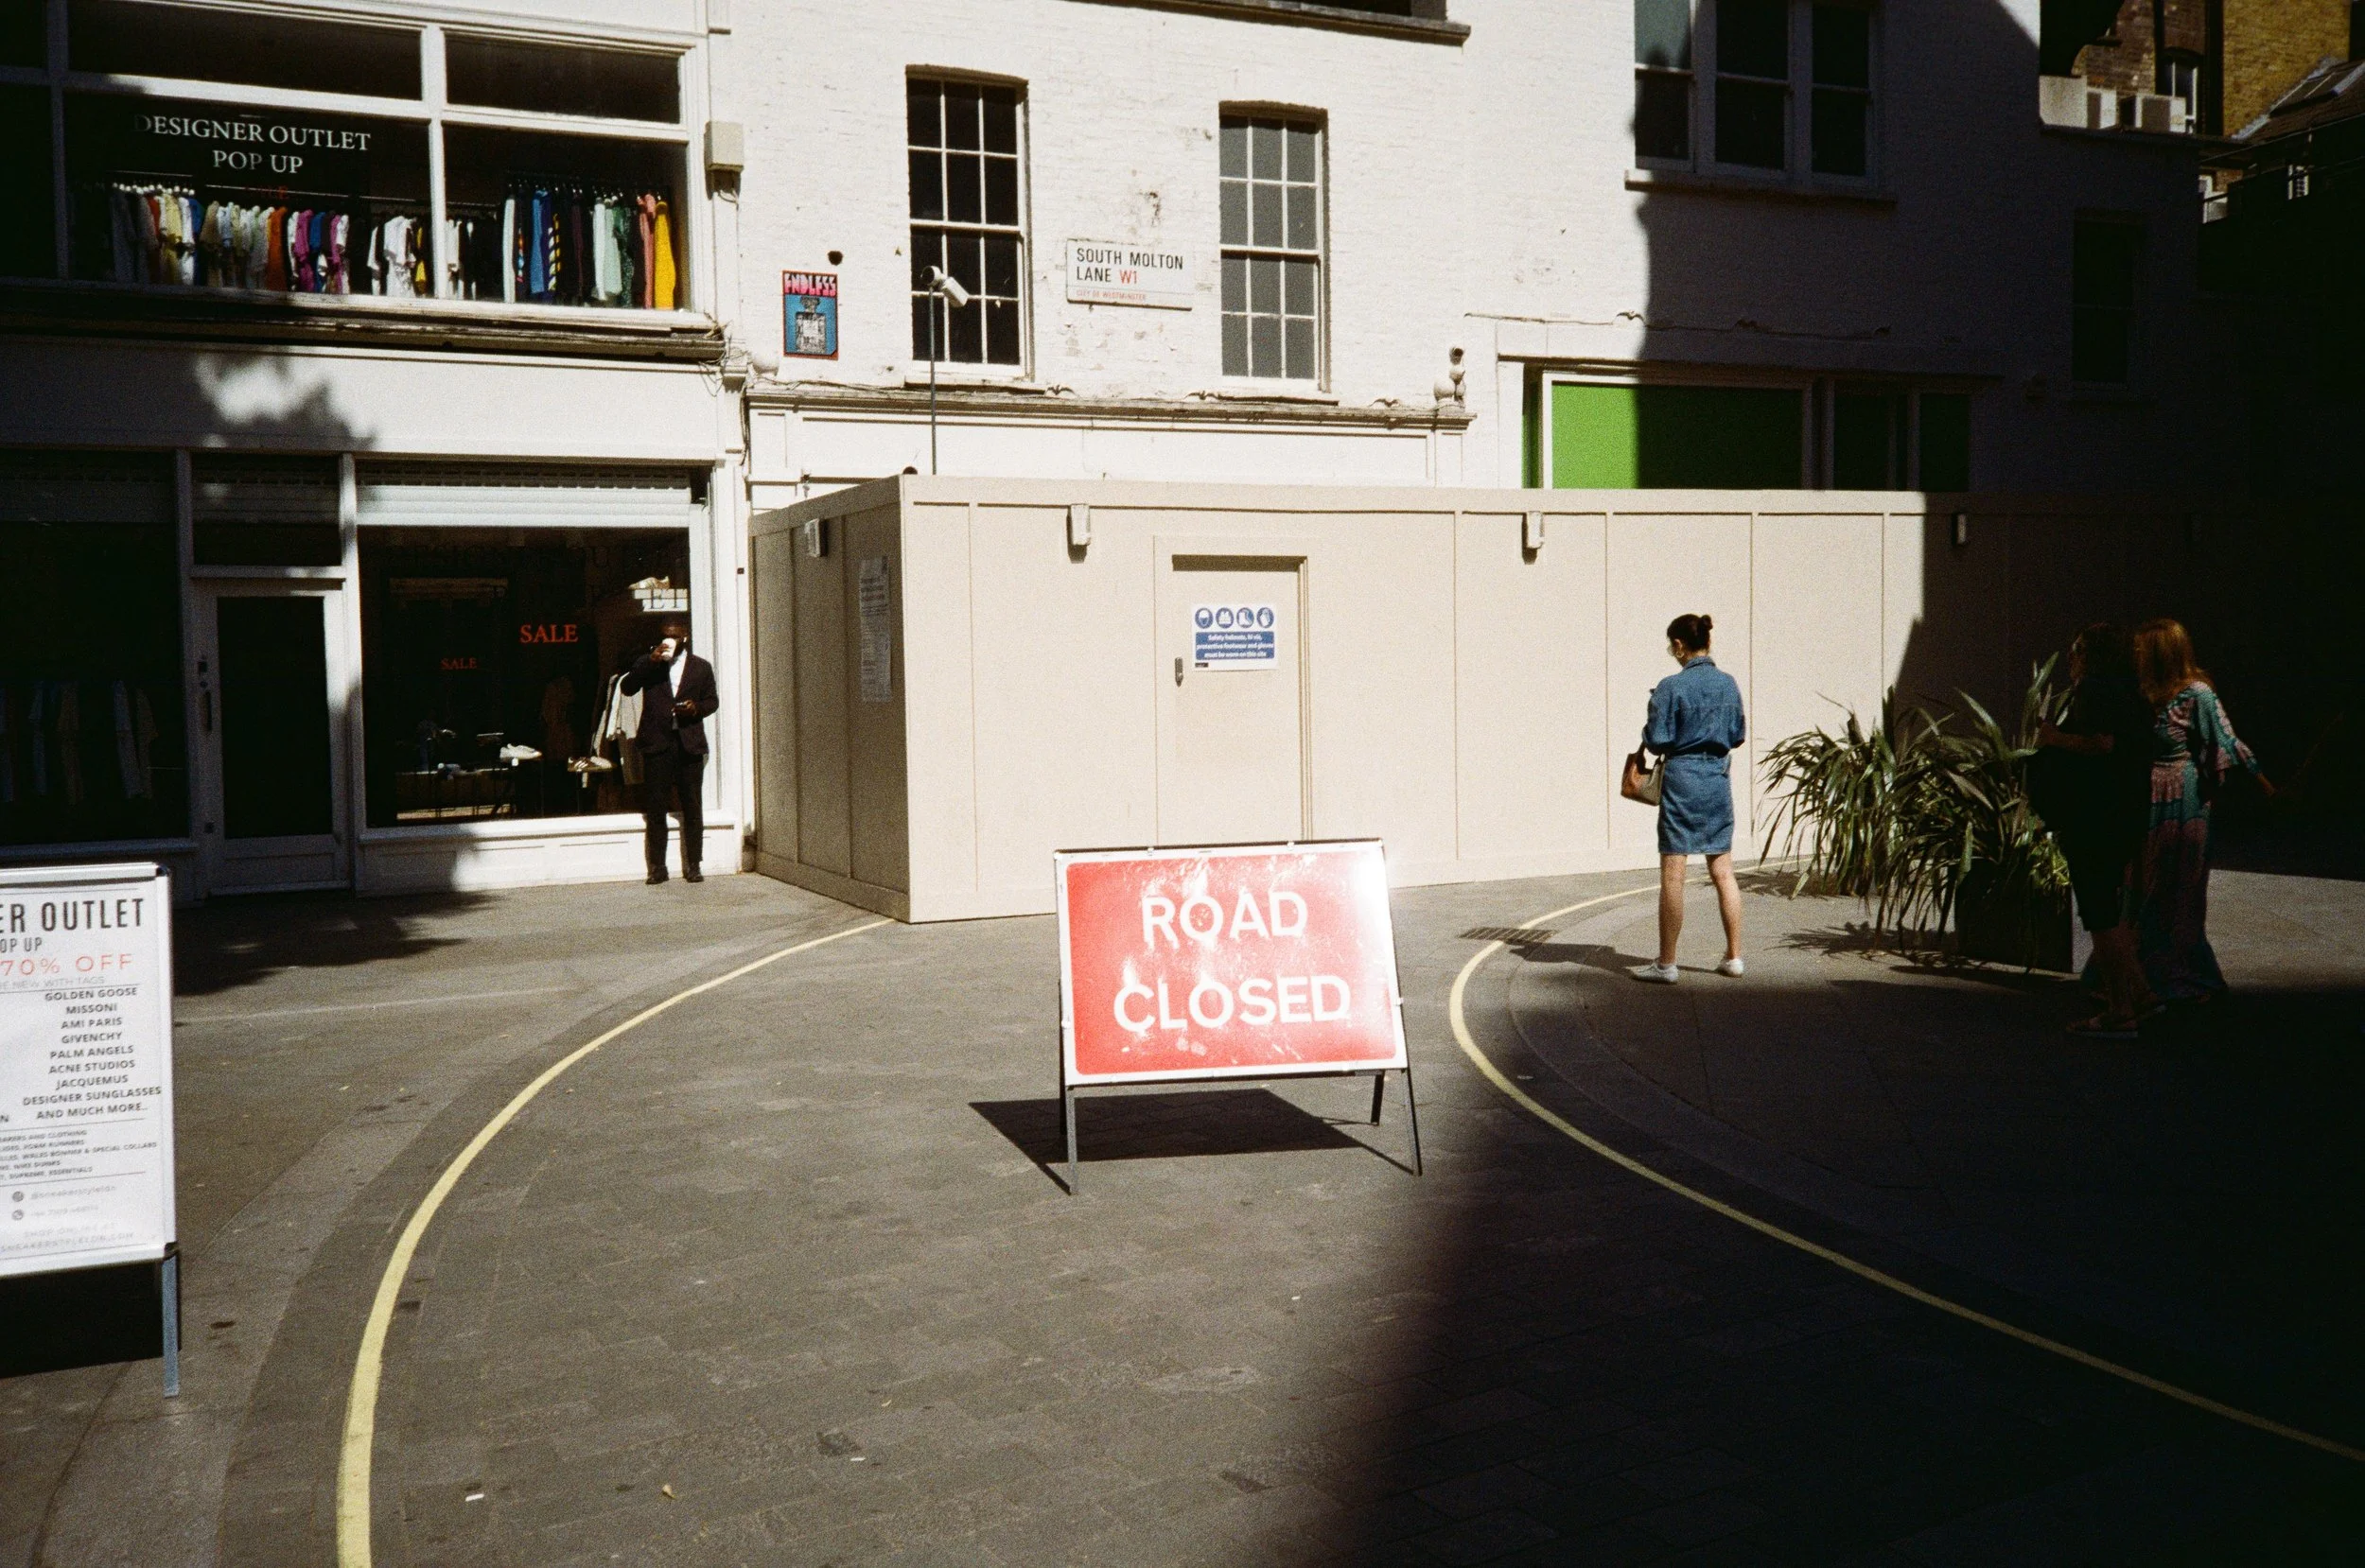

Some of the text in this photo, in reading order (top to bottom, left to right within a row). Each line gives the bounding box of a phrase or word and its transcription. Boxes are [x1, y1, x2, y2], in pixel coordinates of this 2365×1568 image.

[133, 113, 372, 151] DESIGNER OUTLET
[212, 149, 303, 174] POP UP
[1077, 248, 1183, 270] SOUTH MOLTON
[1077, 267, 1138, 284] LANE W1
[784, 272, 836, 297] ENDLESS
[518, 623, 579, 644] SALE
[441, 657, 478, 671] SALE
[41, 897, 145, 932] OUTLET
[1141, 891, 1308, 950] ROAD
[24, 936, 43, 952] UP
[1, 953, 132, 977] 70% OFF
[78, 975, 105, 984] TAGS
[45, 987, 137, 1002] GOLDEN GOOSE
[66, 1002, 117, 1015] MISSONI
[1113, 975, 1352, 1033] CLOSED
[61, 1017, 123, 1030] AMI PARIS
[61, 1032, 122, 1044] GIVENCHY
[50, 1045, 134, 1059] PALM ANGELS
[48, 1059, 136, 1074] ACNE STUDIOS
[56, 1074, 129, 1090] JACQUEMUS
[23, 1087, 162, 1106] DESIGNER SUNGLASSES
[36, 1109, 63, 1120] AND
[67, 1106, 104, 1118] MUCH
